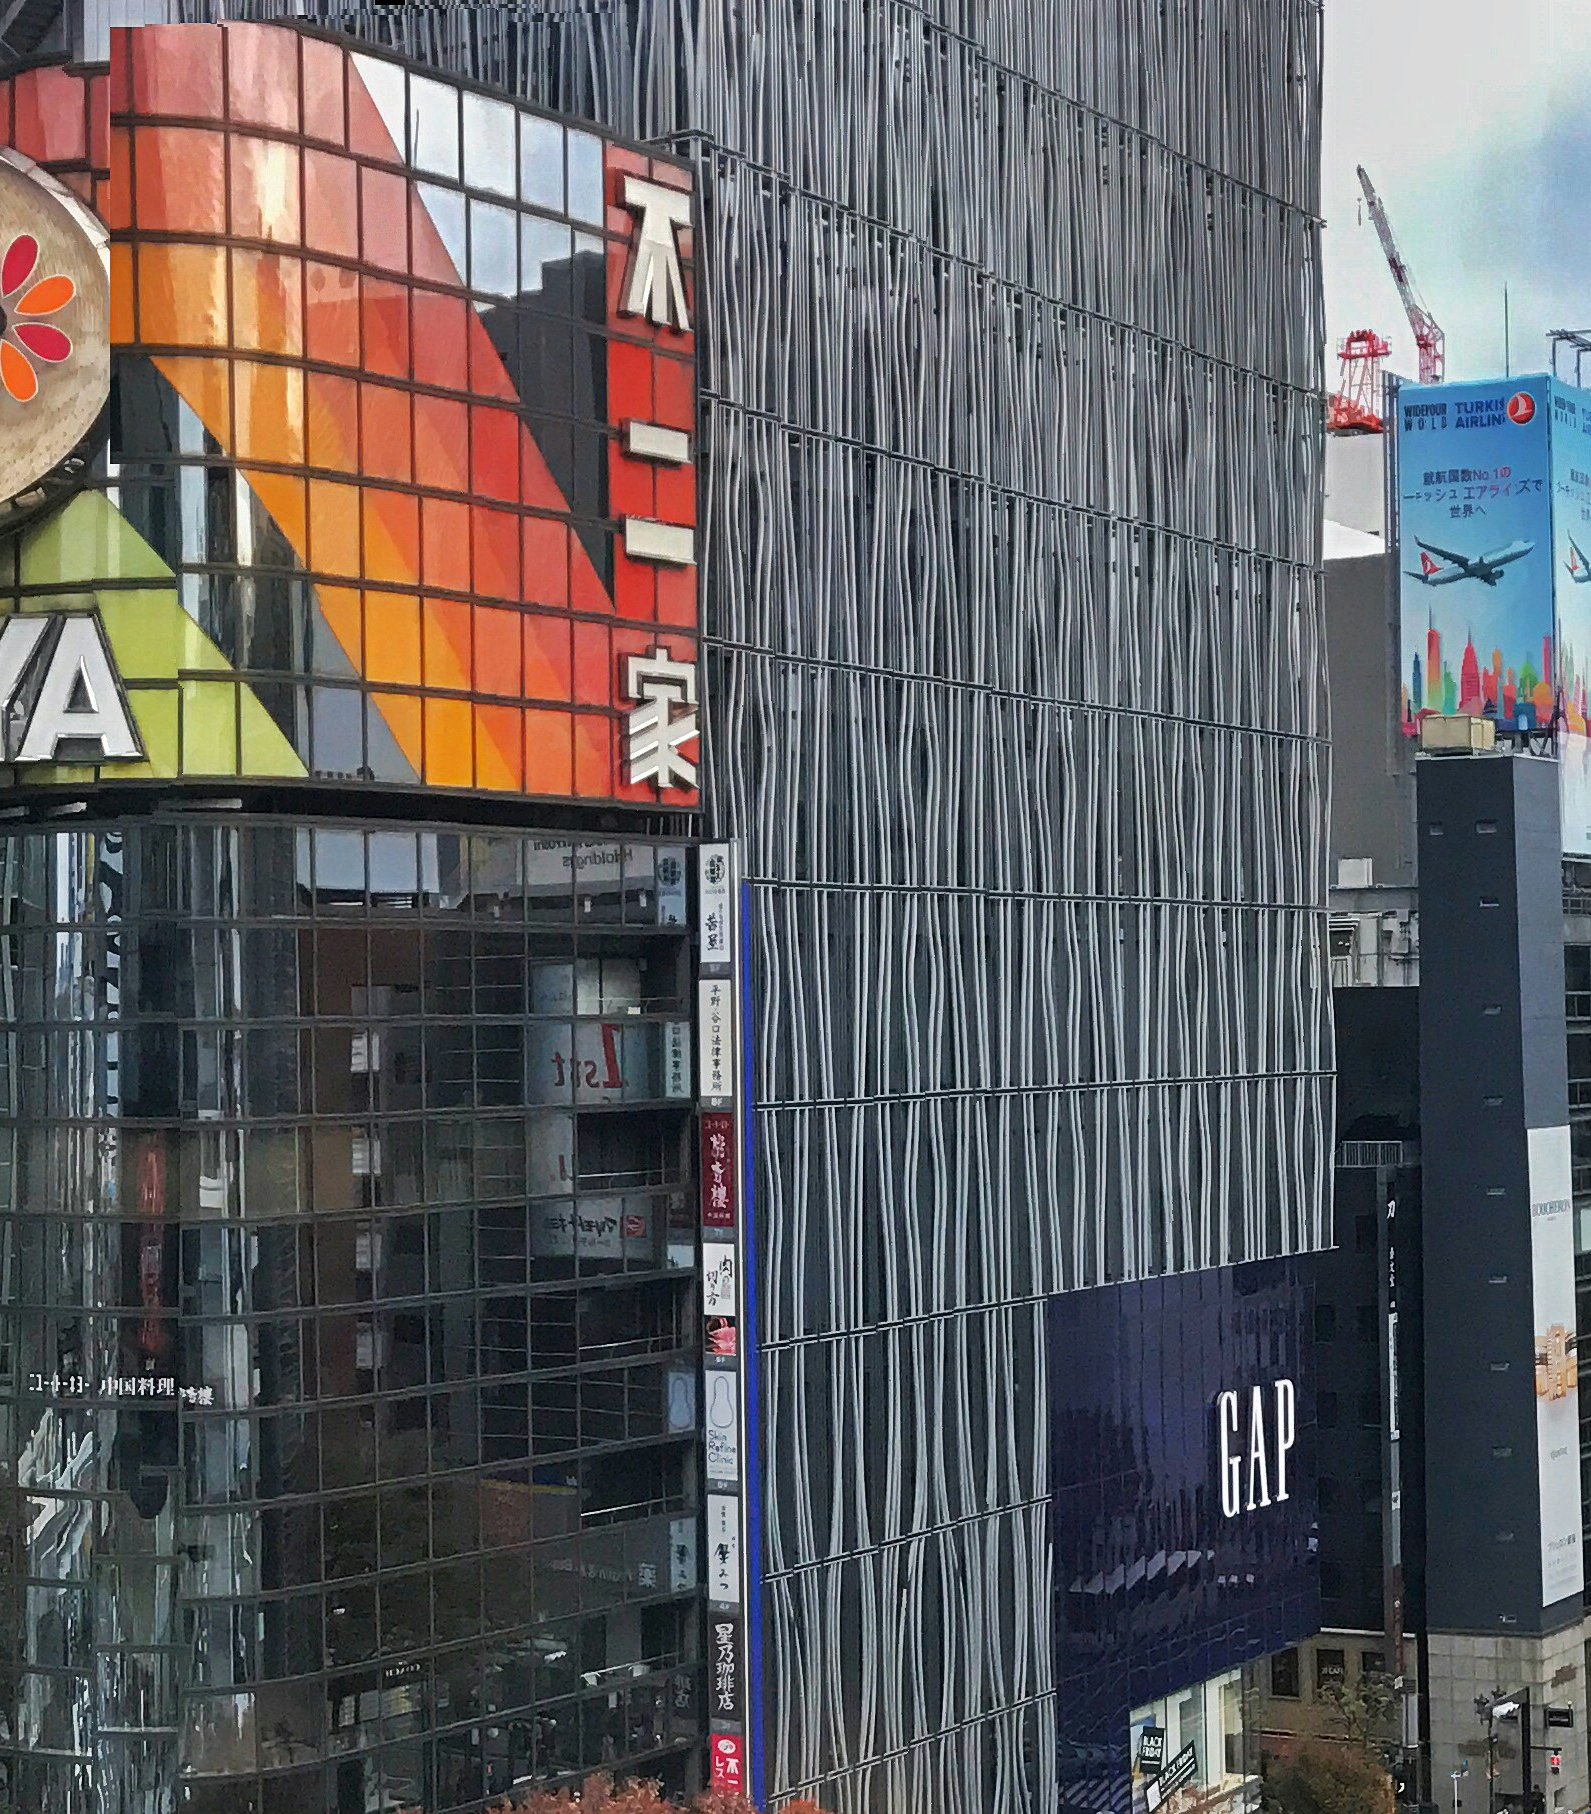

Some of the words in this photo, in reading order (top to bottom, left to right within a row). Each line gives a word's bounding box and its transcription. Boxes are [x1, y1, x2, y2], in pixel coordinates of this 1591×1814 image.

[622, 174, 699, 791] 不二家
[1449, 504, 1487, 519] 世界へ
[101, 1376, 175, 1396] 中国料理
[708, 1441, 737, 1453] Refine
[1218, 1377, 1298, 1519] GAP
[708, 1452, 734, 1464] Clinic
[714, 1623, 735, 1711] 星乃珈琲店
[1143, 1735, 1163, 1747] BLACK
